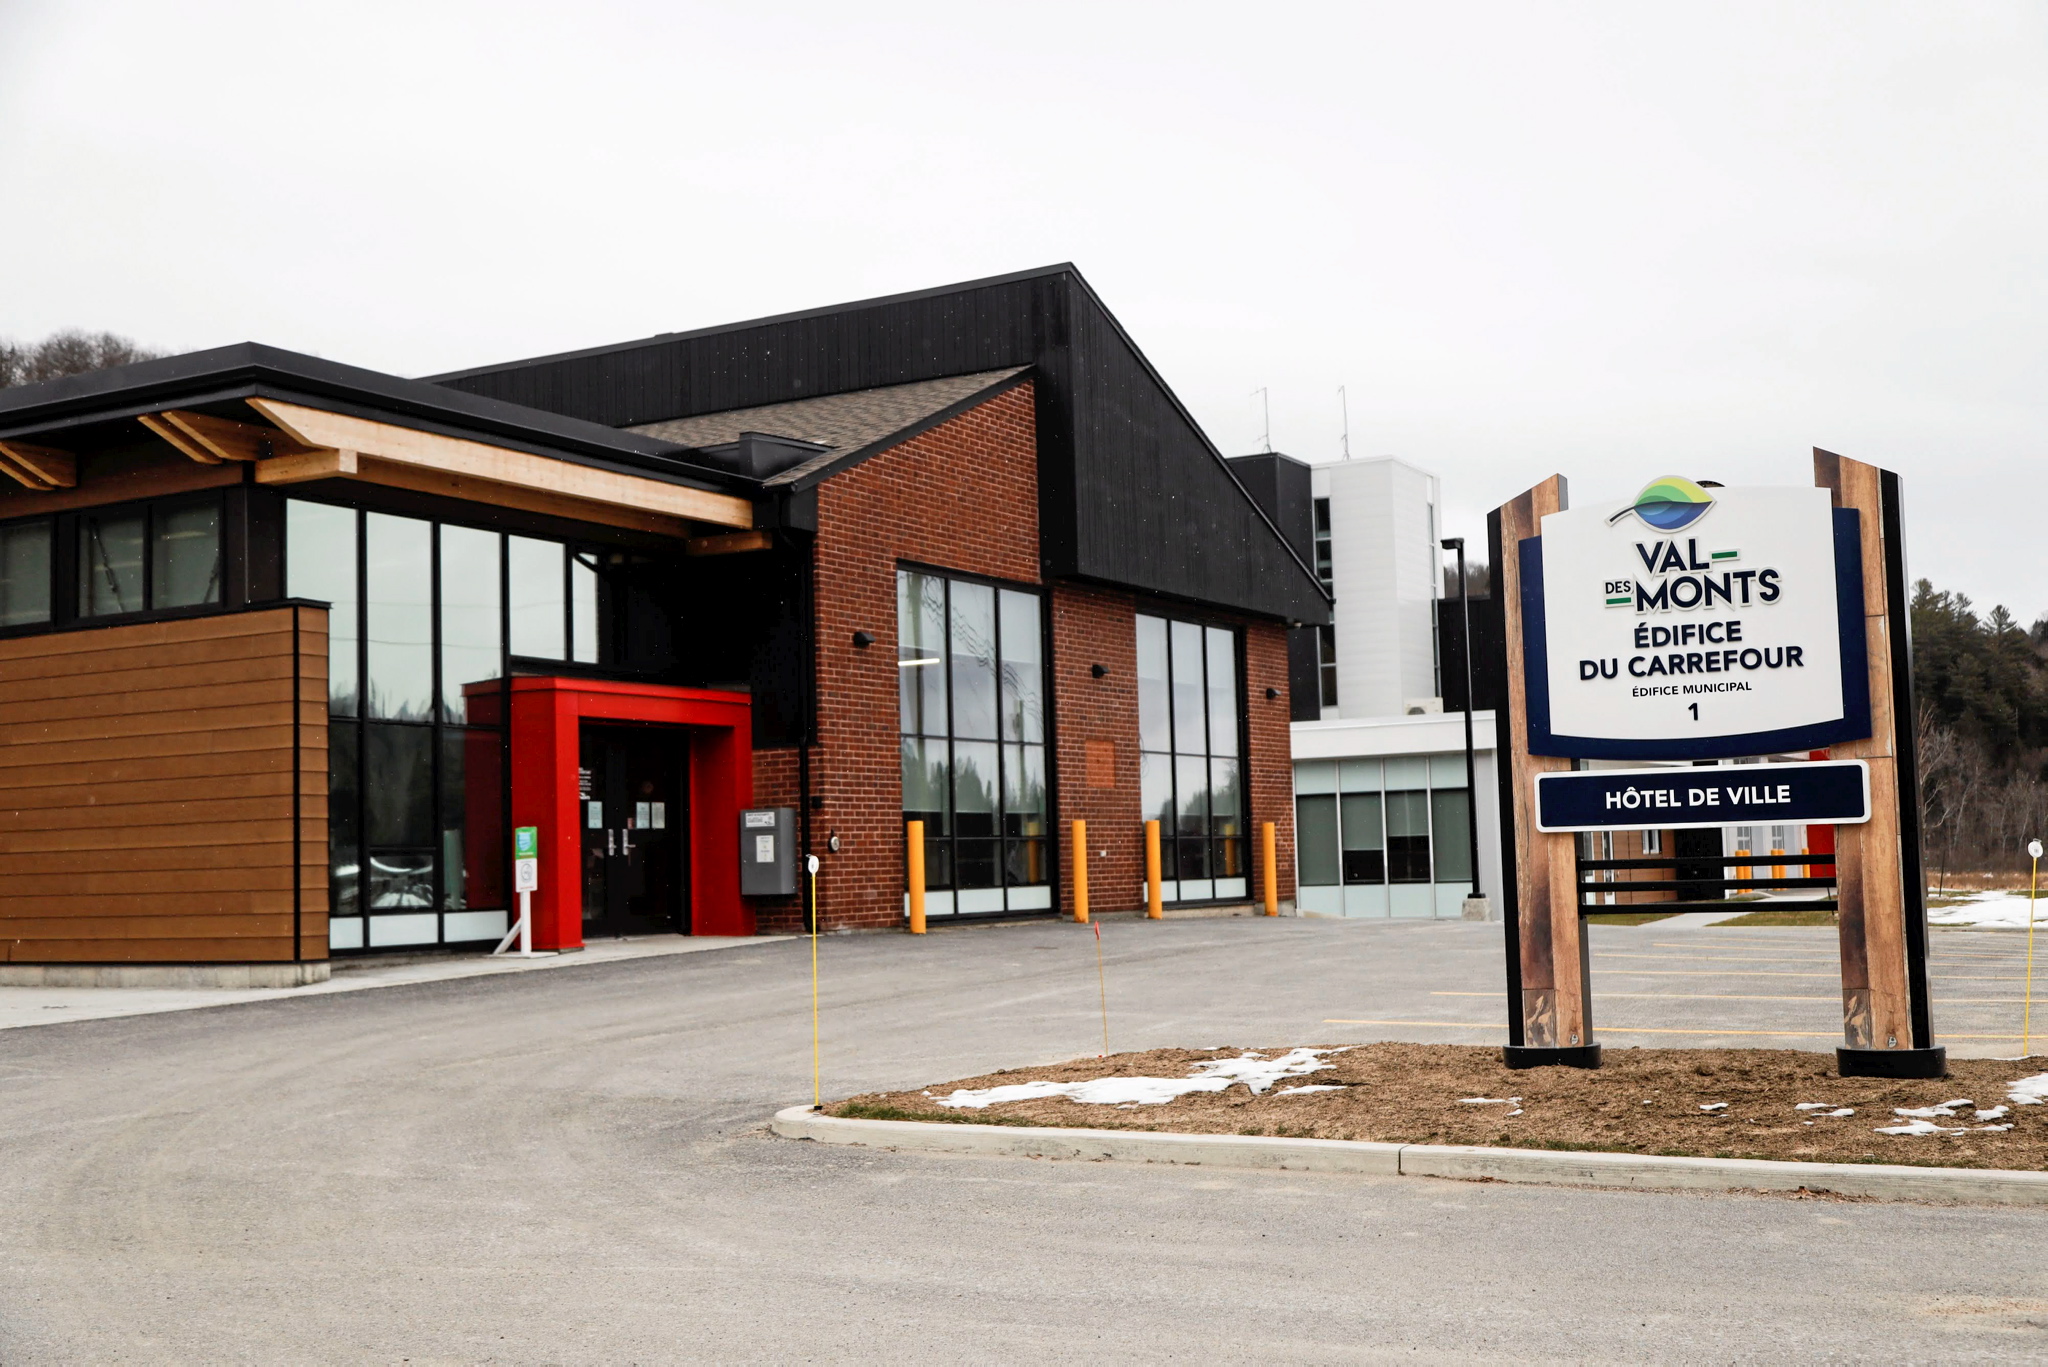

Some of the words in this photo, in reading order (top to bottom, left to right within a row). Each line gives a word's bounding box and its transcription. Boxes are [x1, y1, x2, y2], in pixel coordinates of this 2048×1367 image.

[1635, 568, 1780, 612] MONTS
[1634, 620, 1743, 649] ÉDIFICE
[1579, 657, 1618, 681] DU
[1627, 645, 1804, 678] CARREFOUR
[1632, 685, 1679, 698] ÉDIFICE
[1682, 681, 1752, 695] MUNICIPAL
[1687, 702, 1699, 721] 1
[1605, 786, 1682, 810] HÔTEL
[1688, 788, 1720, 807] DE
[1726, 784, 1791, 805] VILLE
